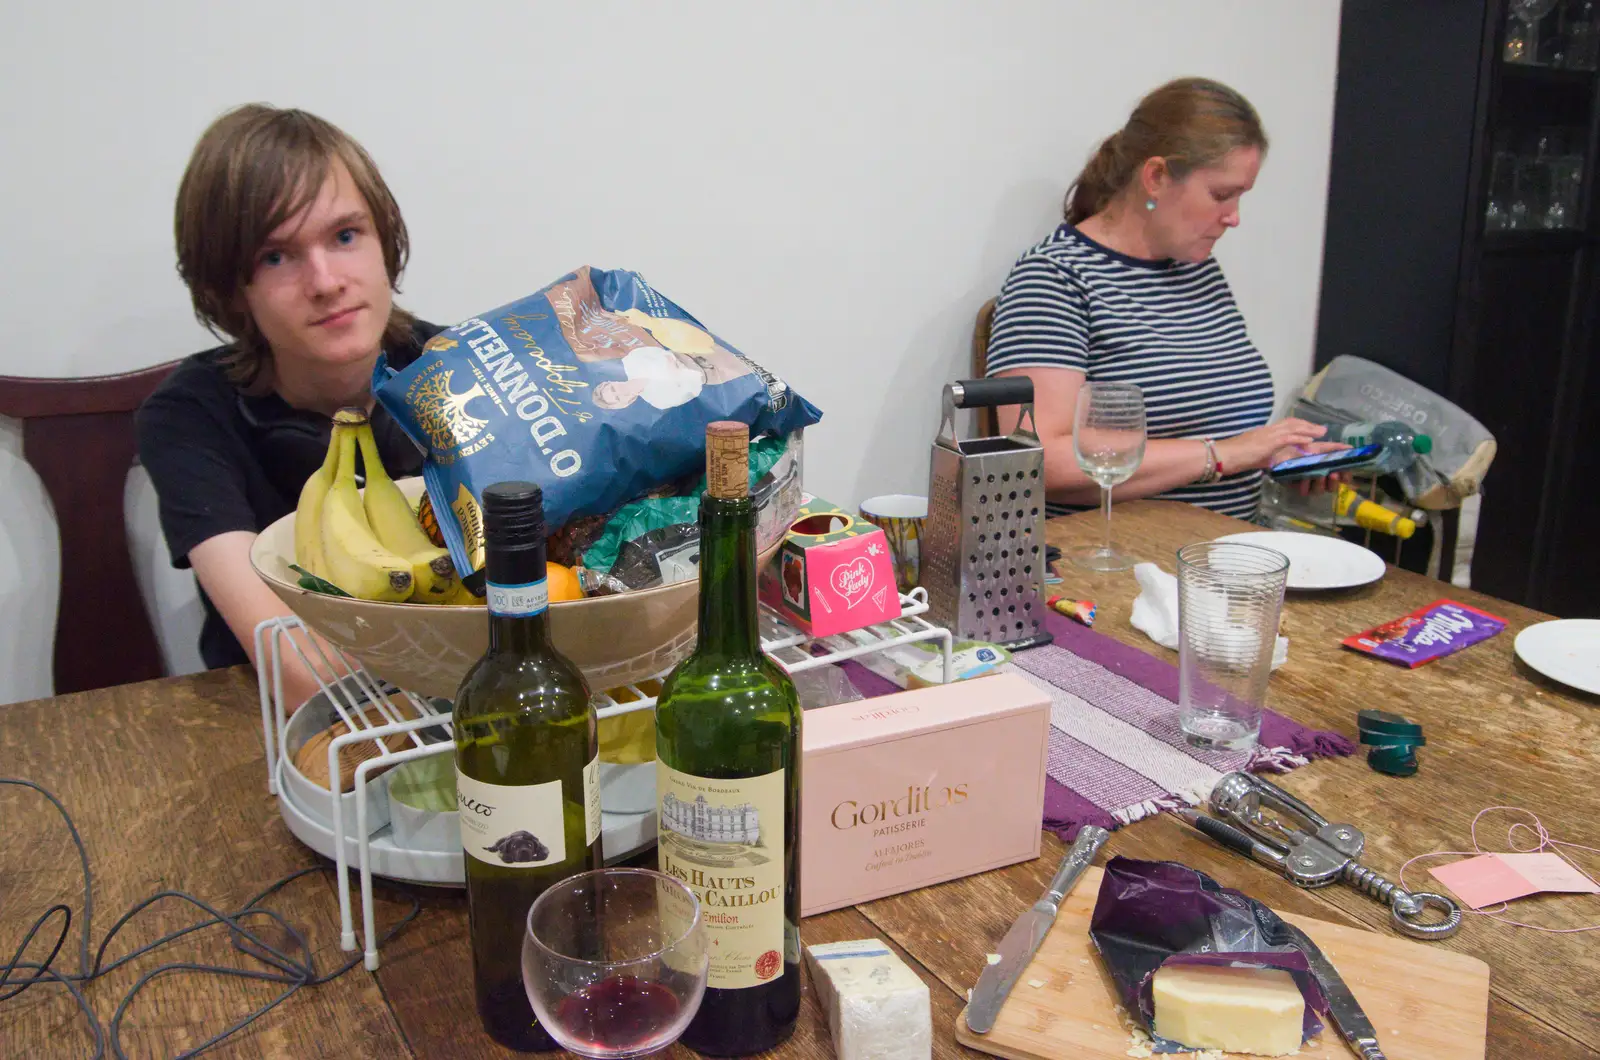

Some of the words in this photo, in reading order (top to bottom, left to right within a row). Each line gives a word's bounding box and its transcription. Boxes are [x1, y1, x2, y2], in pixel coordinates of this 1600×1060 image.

[501, 312, 590, 415] Tipperary
[450, 317, 582, 478] O'DONNELLS
[838, 561, 866, 588] Pink
[844, 574, 870, 598] Lady
[1412, 611, 1475, 646] Milka
[830, 783, 969, 831] Gorditas
[873, 818, 926, 838] PATISSERIE
[665, 855, 688, 882] LES
[691, 868, 756, 890] HAUTS
[705, 884, 781, 908] CAILLOU
